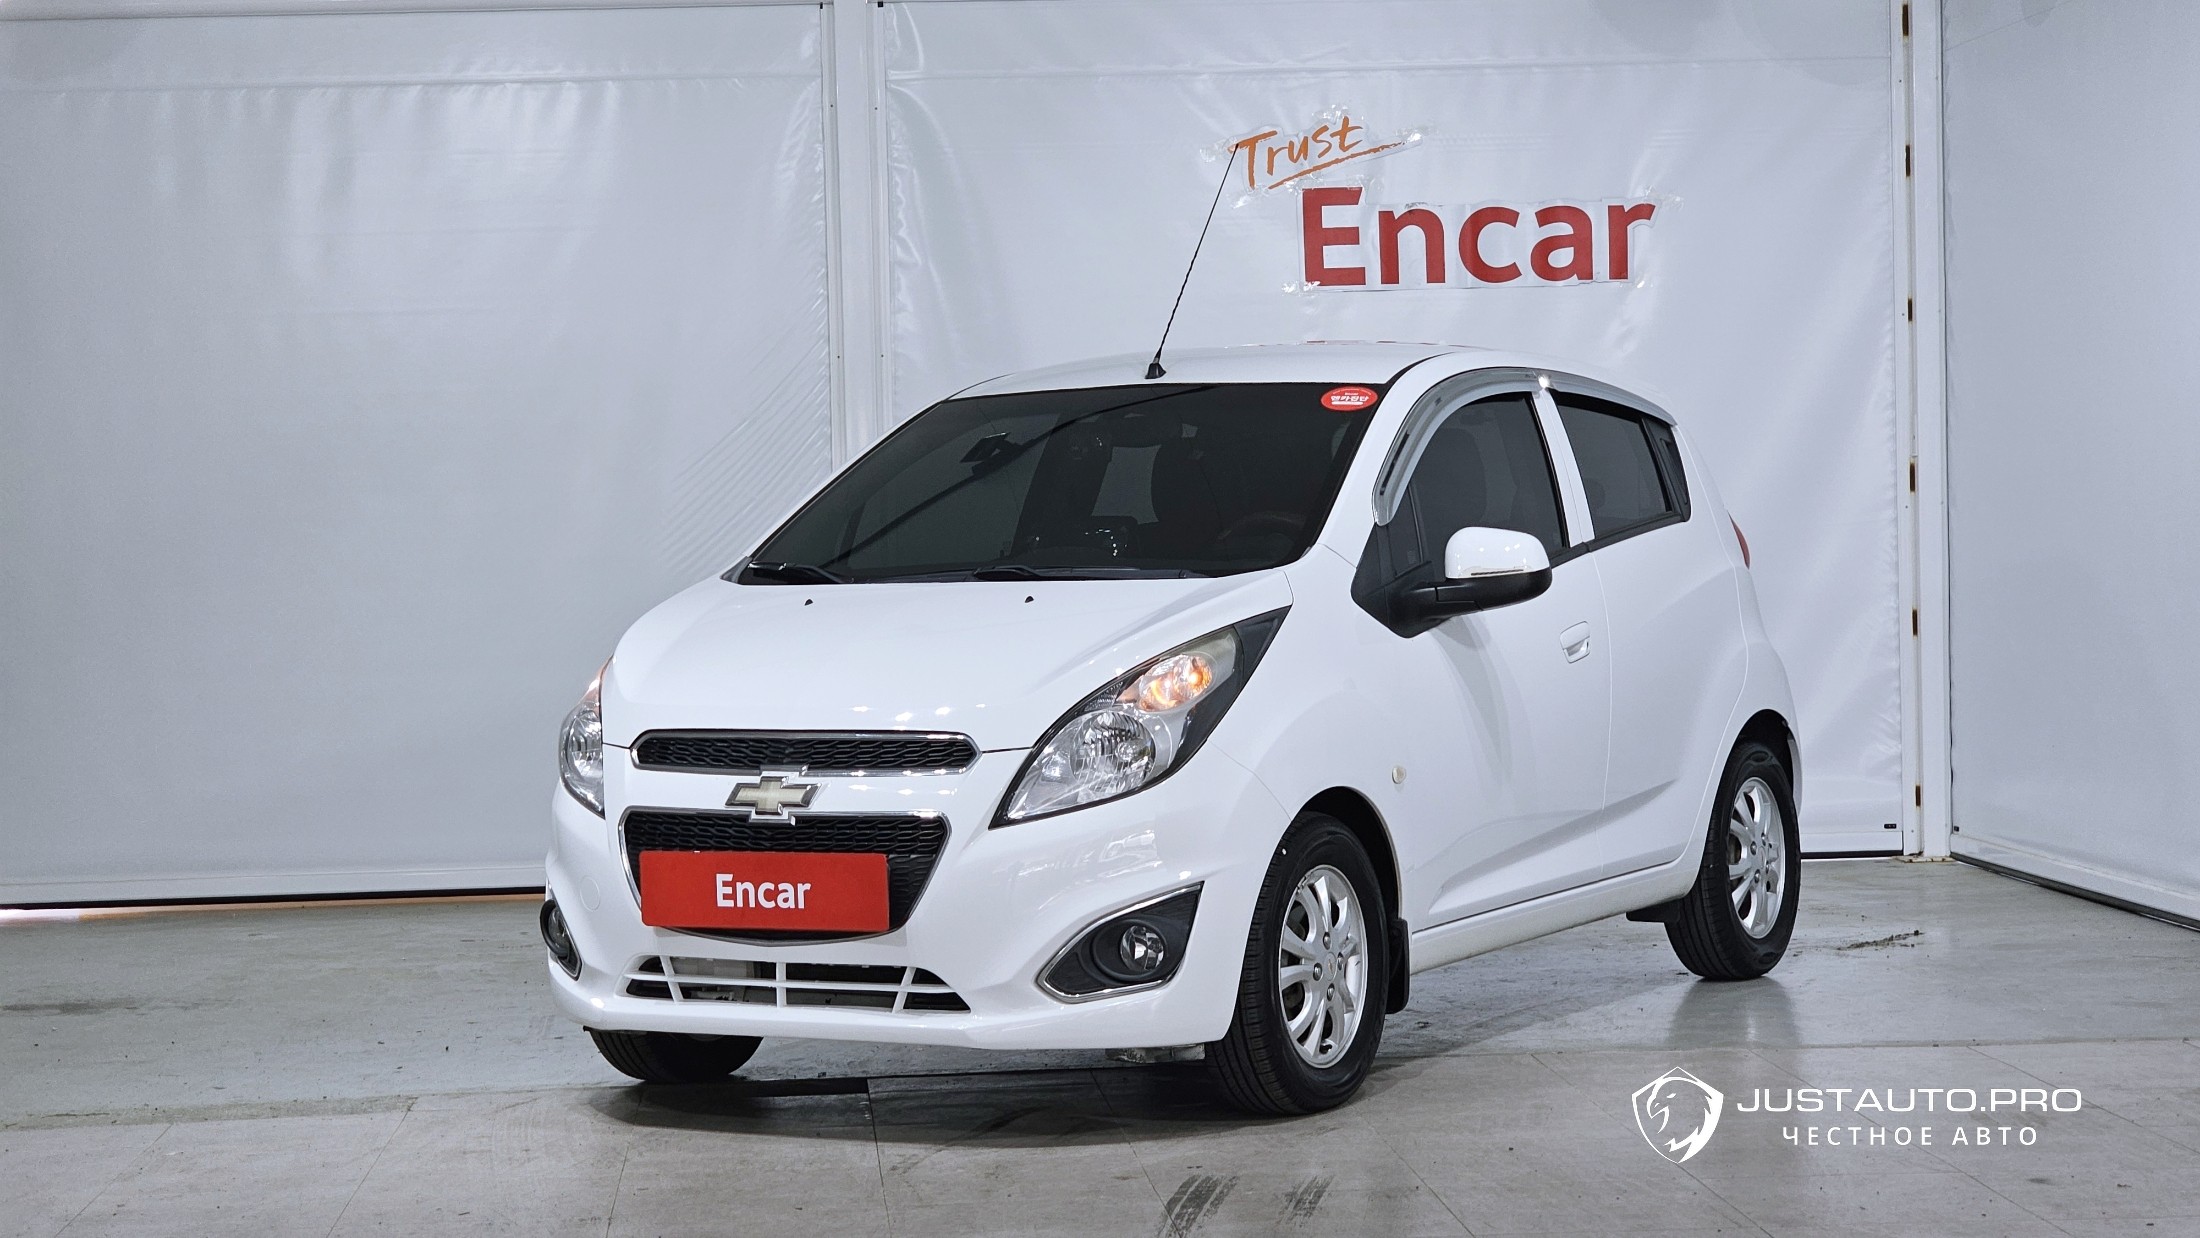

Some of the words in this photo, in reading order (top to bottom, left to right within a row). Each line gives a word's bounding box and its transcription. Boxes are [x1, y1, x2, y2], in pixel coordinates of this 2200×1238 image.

[1229, 117, 1365, 189] Trust
[1302, 187, 1656, 286] Encar
[715, 873, 811, 909] Encar
